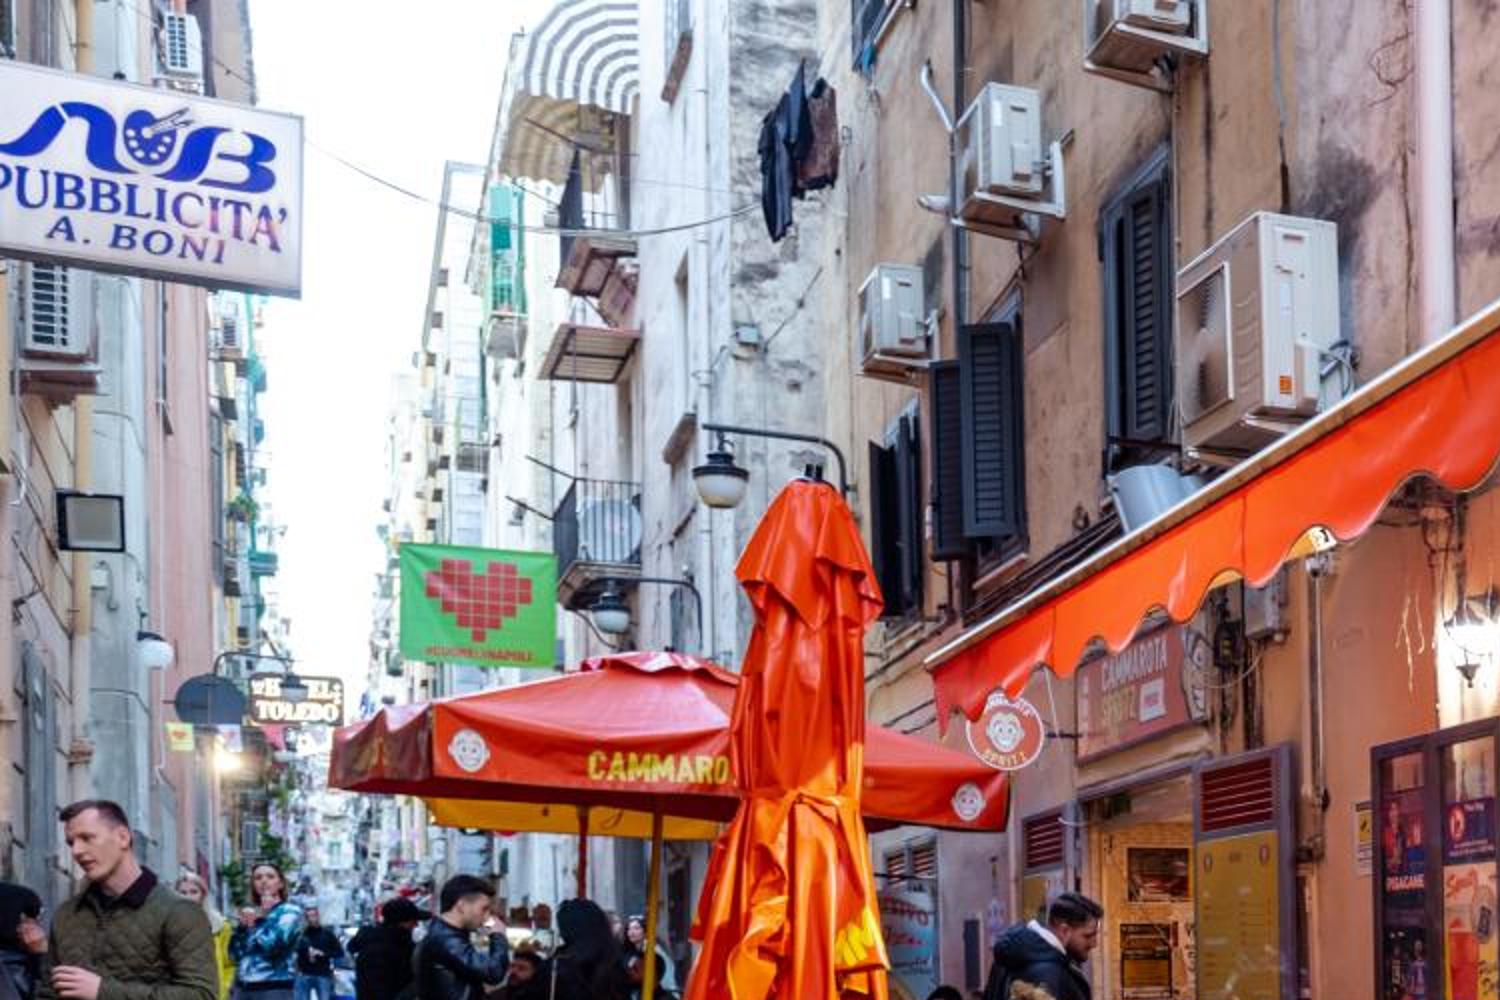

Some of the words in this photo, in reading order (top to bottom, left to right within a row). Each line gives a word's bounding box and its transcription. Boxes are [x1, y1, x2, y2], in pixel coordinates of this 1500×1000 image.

[46, 216, 91, 244] A.
[108, 224, 225, 264] BONI
[264, 677, 332, 700] HEL
[256, 701, 340, 721] TOLEDO
